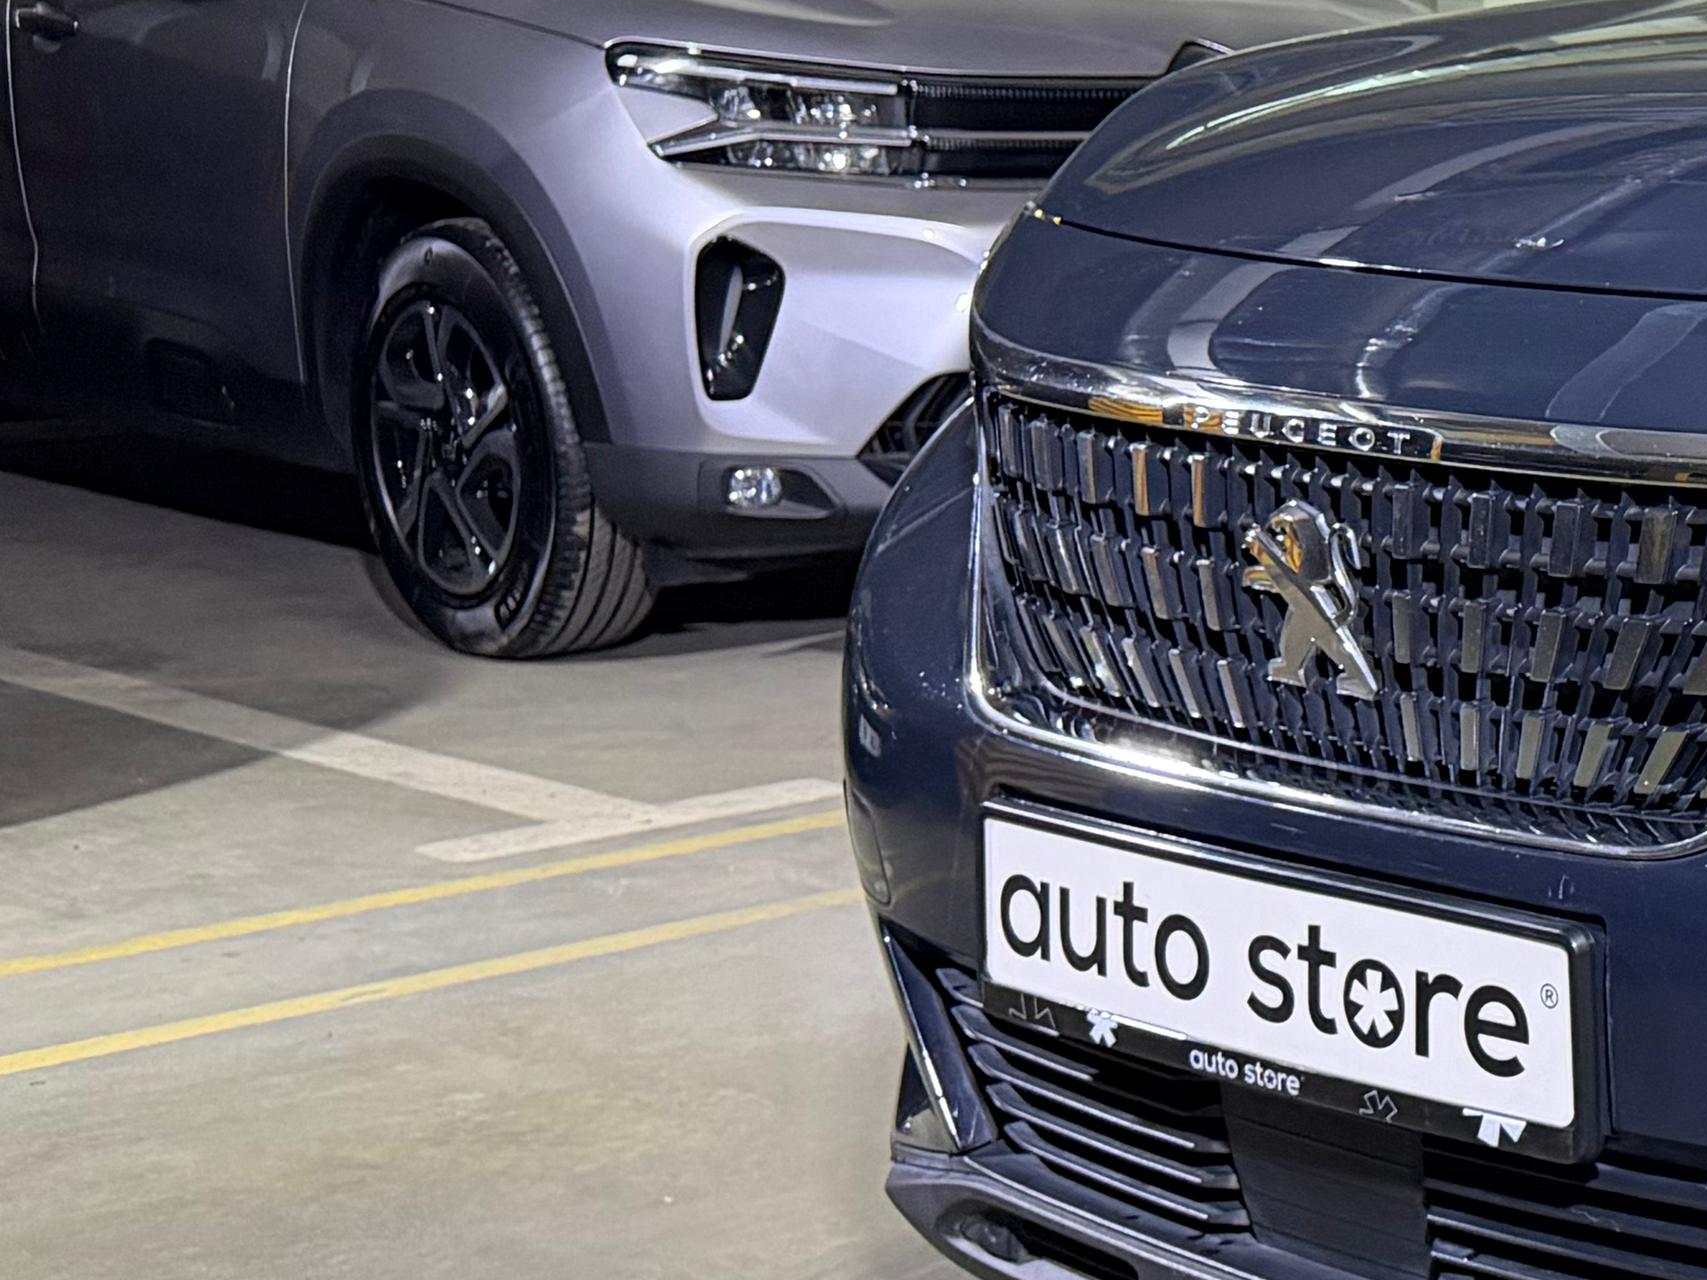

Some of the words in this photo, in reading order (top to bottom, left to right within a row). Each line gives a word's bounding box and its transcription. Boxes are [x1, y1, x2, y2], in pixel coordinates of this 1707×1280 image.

[1191, 405, 1411, 455] PEUGEOT
[1000, 873, 1210, 1001] auto
[1247, 925, 1530, 1078] store
[1189, 1049, 1239, 1079] auto
[1244, 1061, 1300, 1096] store
